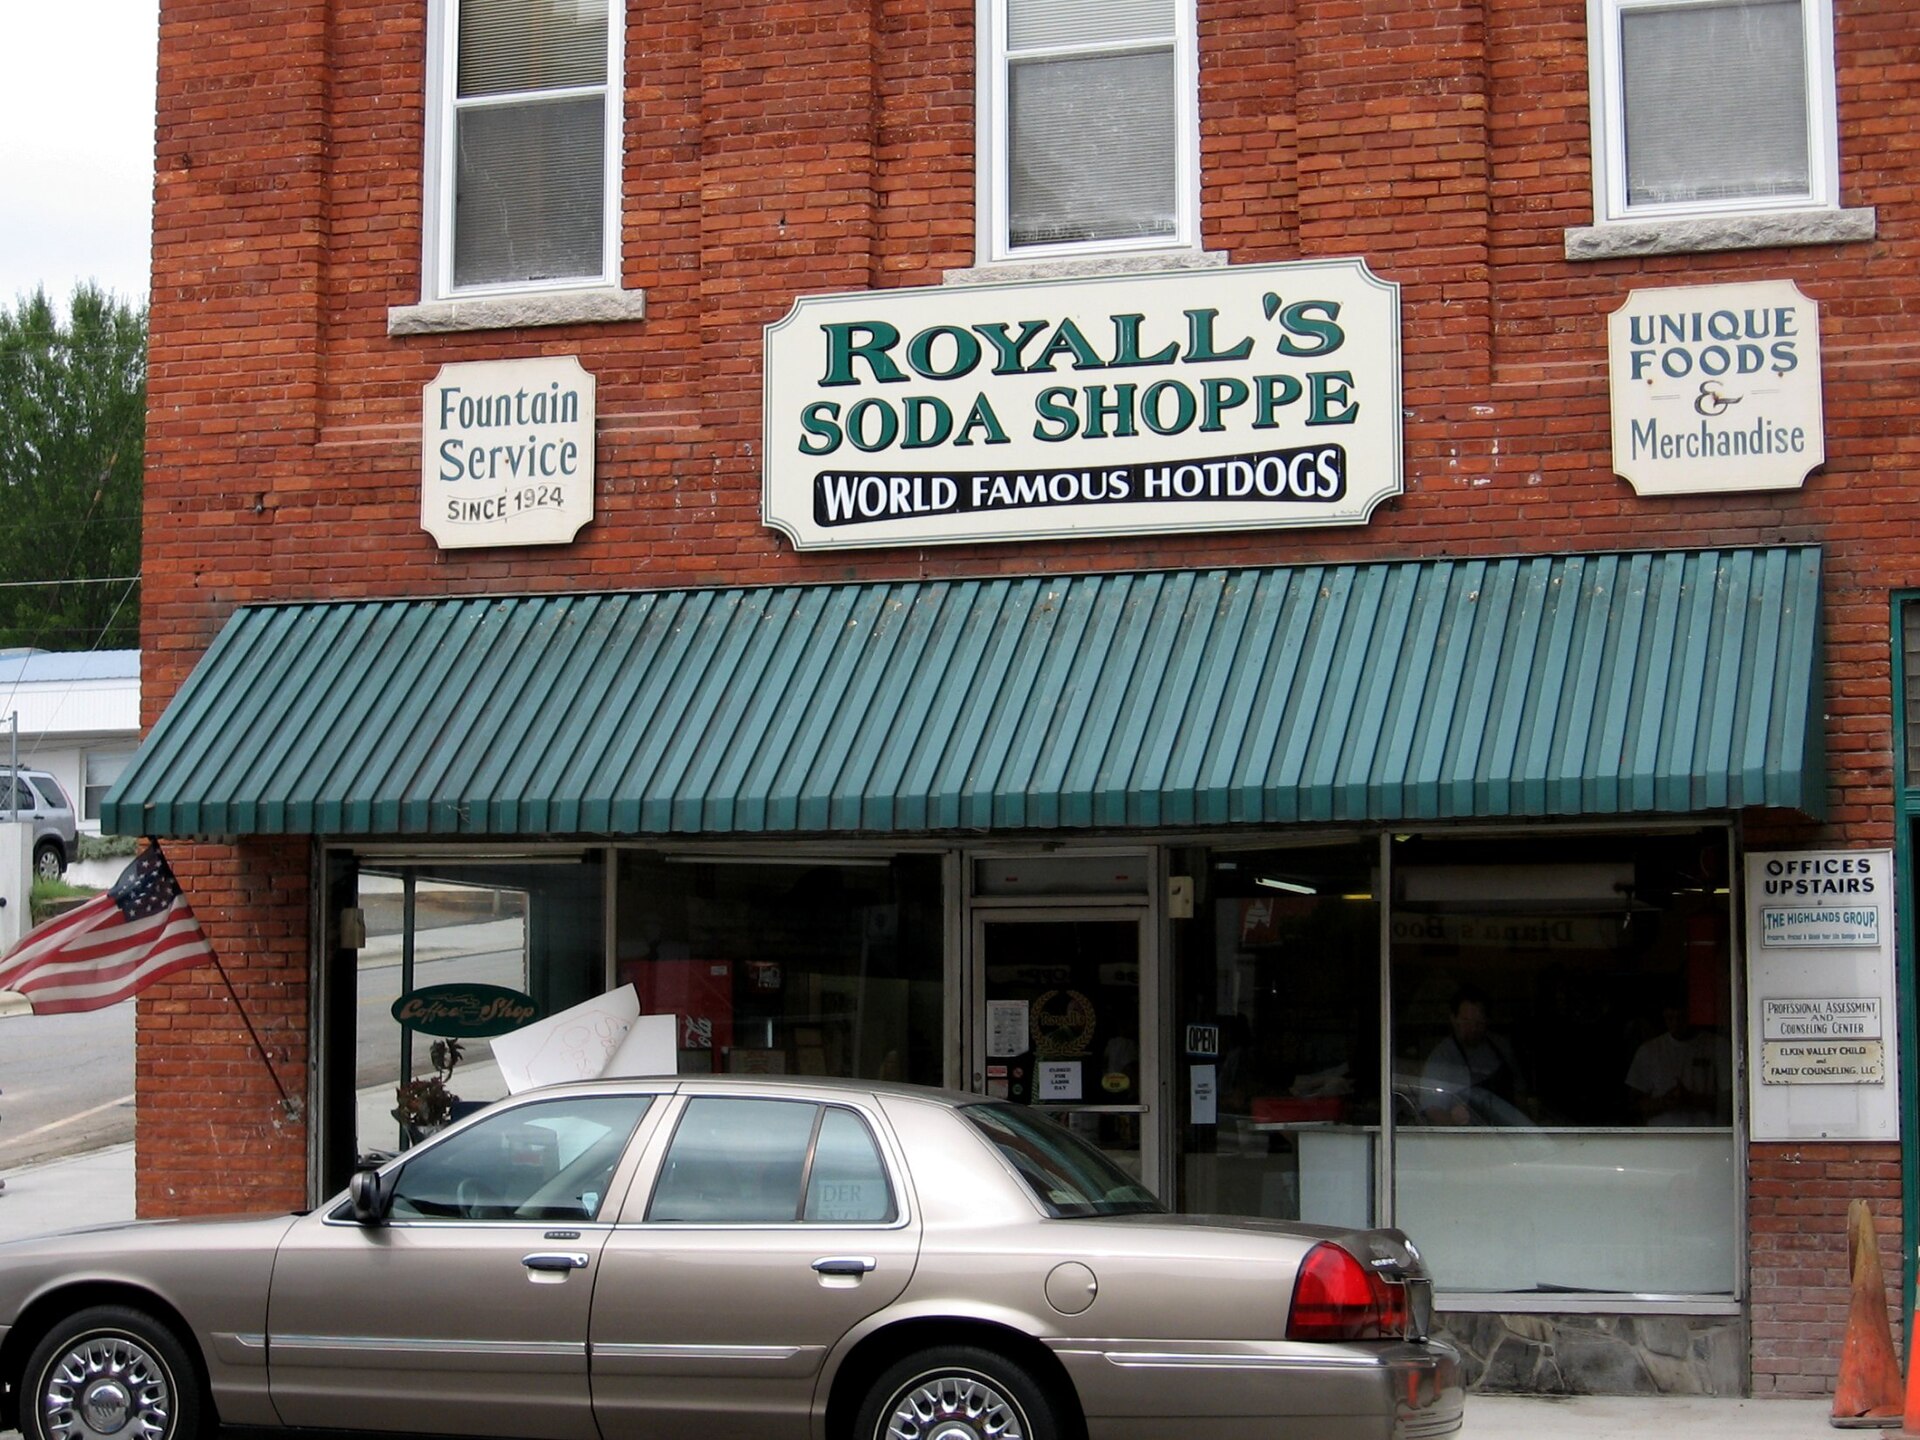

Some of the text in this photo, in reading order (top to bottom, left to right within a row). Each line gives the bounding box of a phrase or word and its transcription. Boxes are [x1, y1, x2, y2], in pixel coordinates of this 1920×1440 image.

[817, 291, 1345, 387] ROYALL'S
[1629, 307, 1799, 345] UNIQUE
[1630, 341, 1798, 380] FOODS
[440, 381, 578, 430] Fountain
[799, 370, 1361, 456] SODA SHOPPE
[1694, 380, 1743, 417] &
[1631, 416, 1805, 461] Merchandise
[440, 435, 577, 482] Service
[447, 485, 564, 521] SINCE 1924
[823, 449, 1340, 522] WORLD FAMOUS HOTDOGS
[1767, 858, 1871, 876] OFFICES
[1765, 877, 1875, 894] UPSTAIRS
[1767, 911, 1875, 930] THE HIGHLANDS GROUP
[400, 998, 535, 1024] Coffee Shop
[1768, 1001, 1876, 1014] PROFESSIONAL ASSESSMENT
[1189, 1026, 1217, 1053] OPEN
[1780, 1022, 1864, 1035] COUNSELING CENTER
[1807, 1047, 1837, 1055] VALLEY
[1771, 1067, 1799, 1075] FAMILY
[1861, 1066, 1876, 1075] LLC
